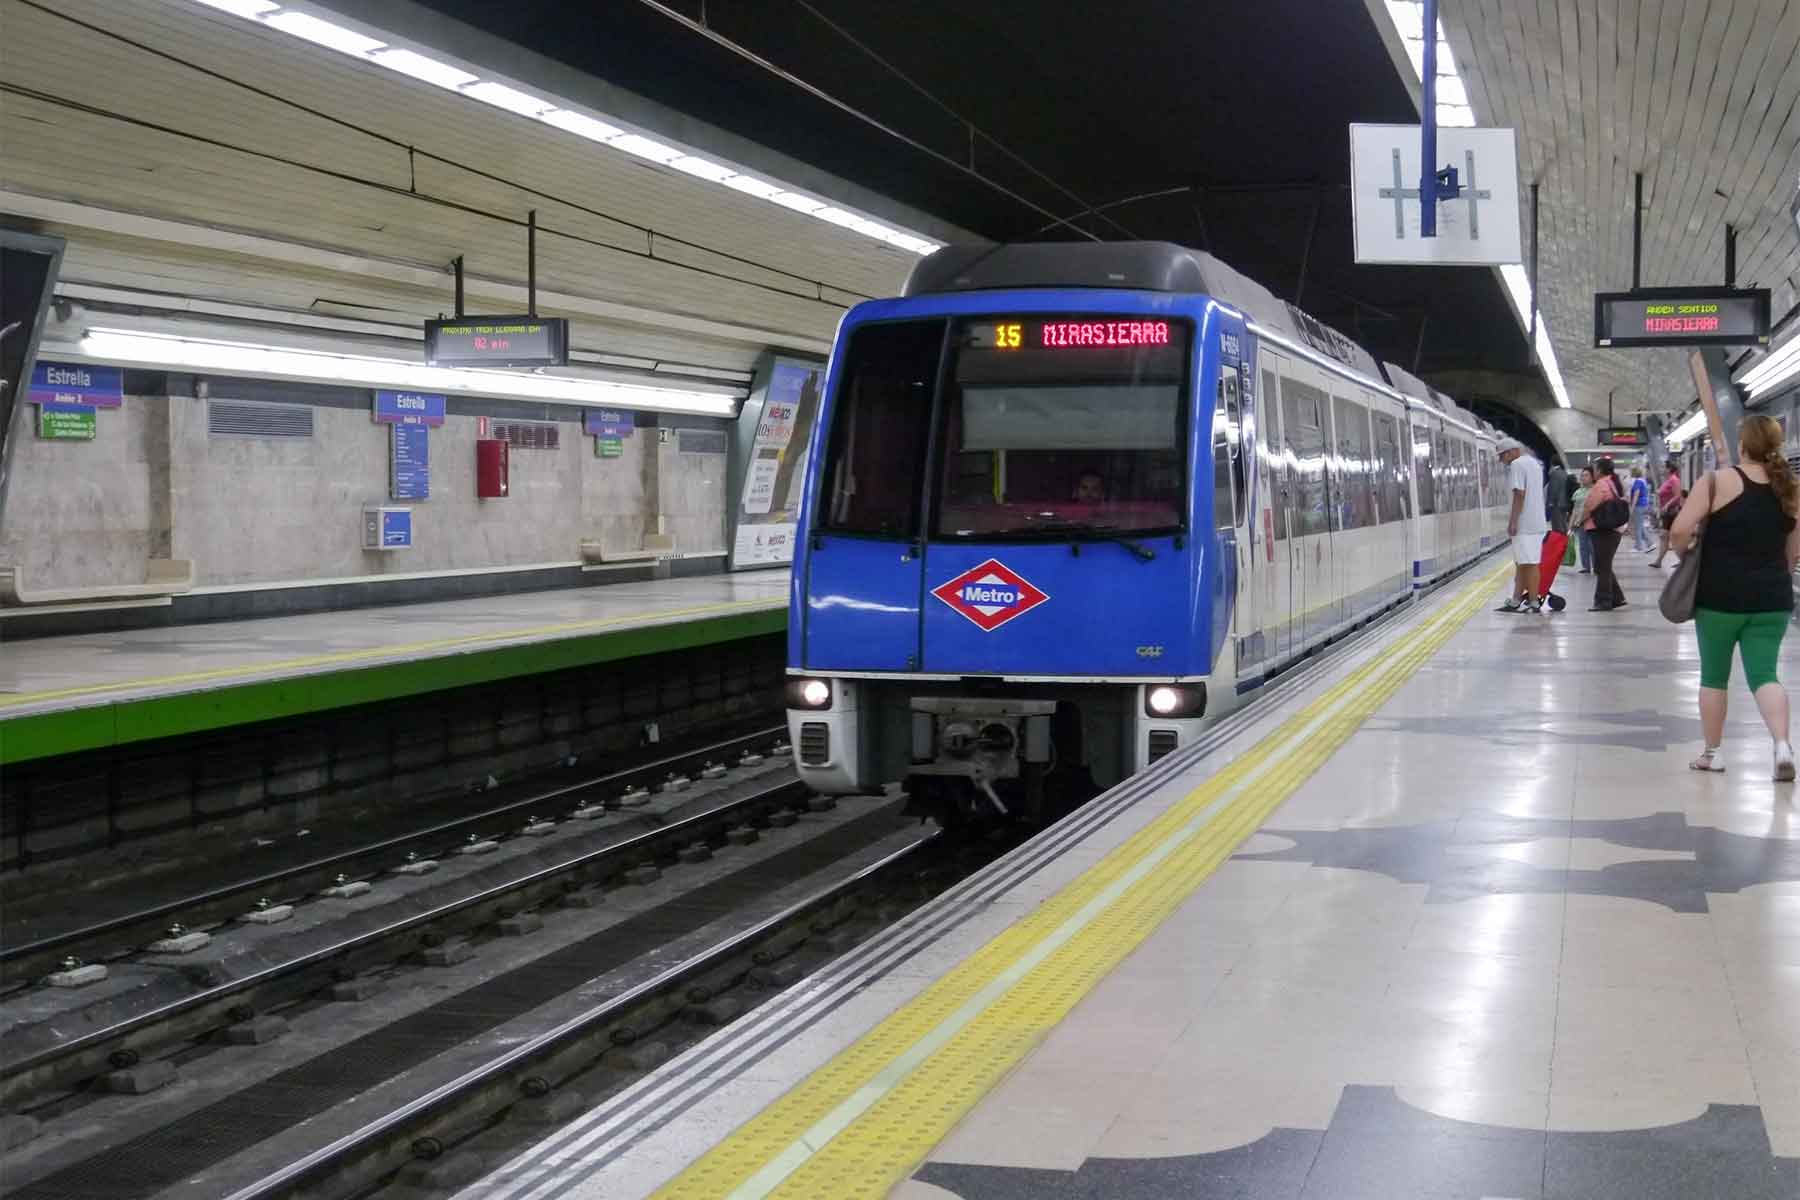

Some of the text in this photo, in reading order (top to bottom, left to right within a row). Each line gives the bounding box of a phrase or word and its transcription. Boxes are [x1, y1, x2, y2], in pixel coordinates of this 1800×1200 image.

[996, 322, 1169, 347] 15 MIRASIERRA
[47, 366, 91, 387] Estrella
[396, 394, 425, 410] Estrella
[965, 586, 1014, 603] Metro
